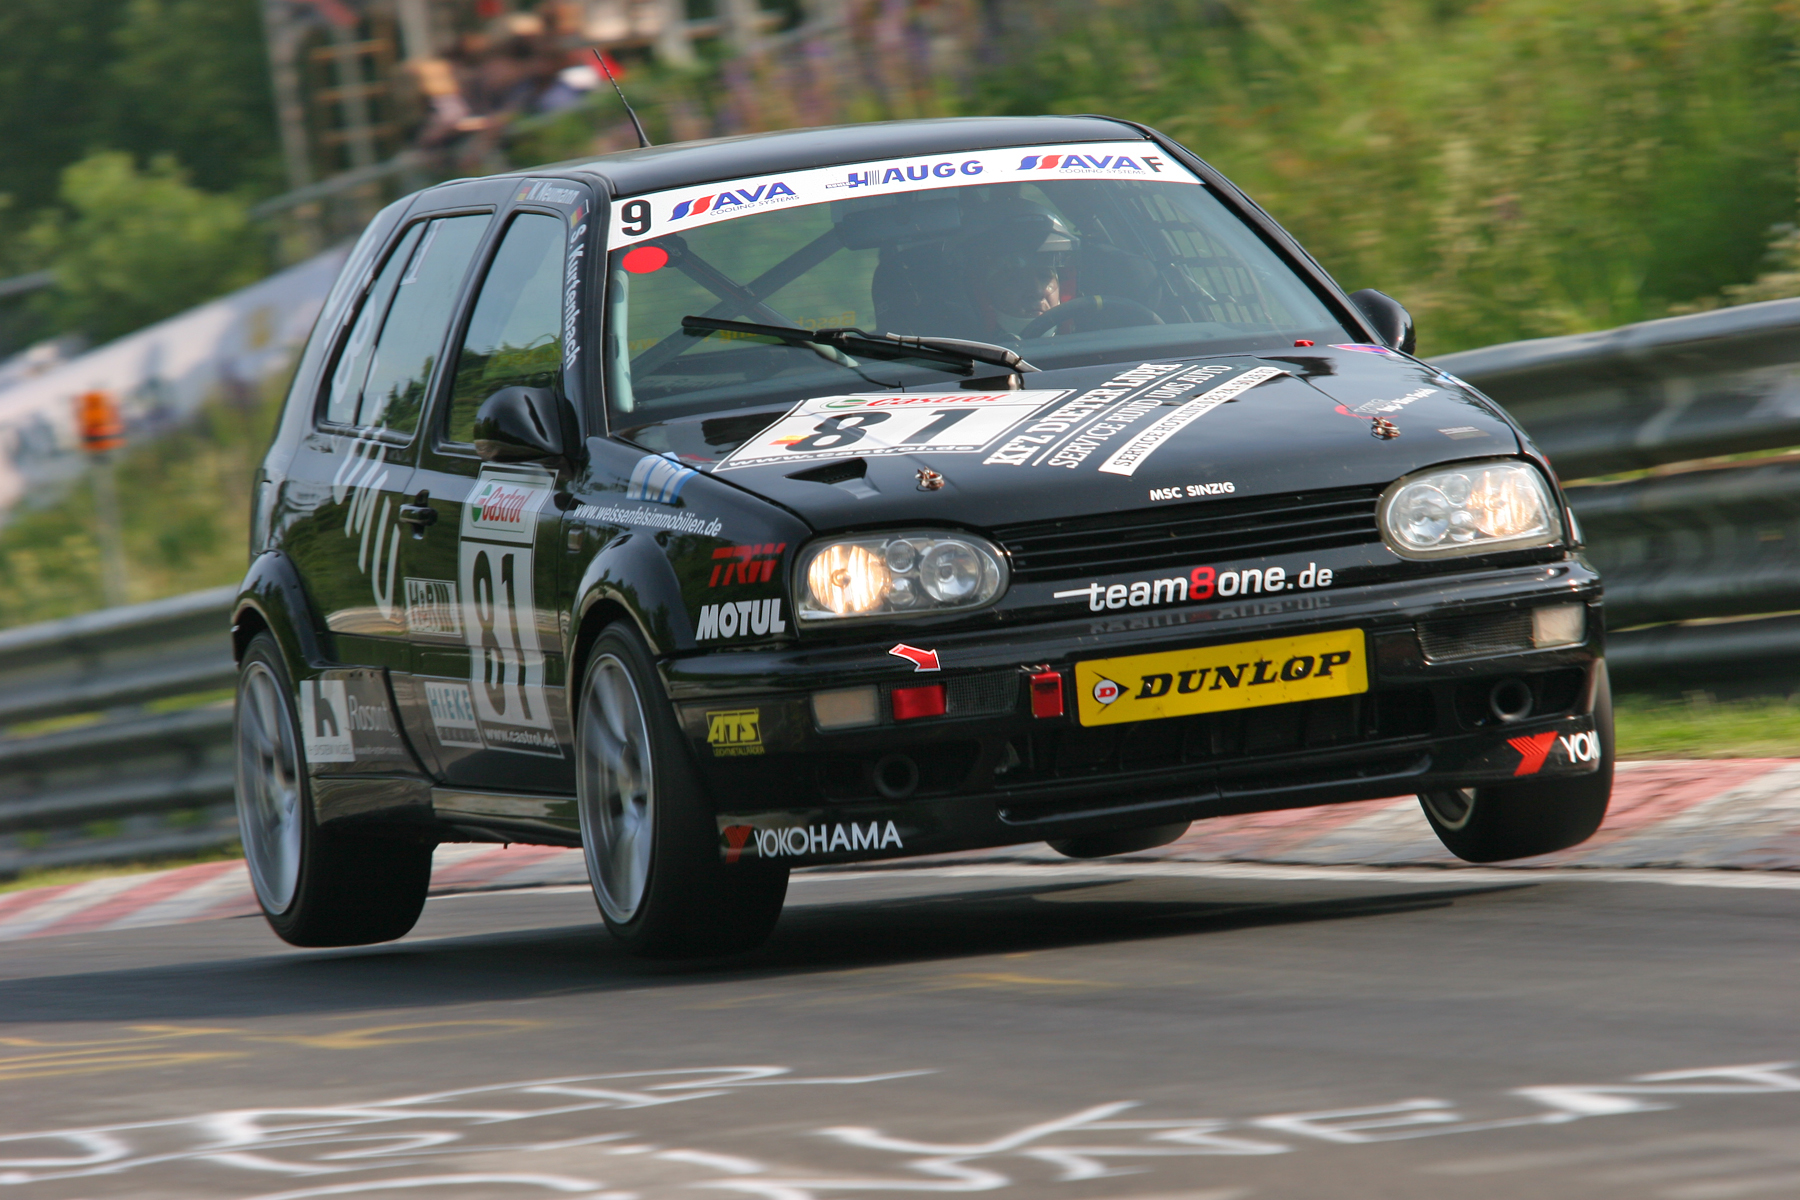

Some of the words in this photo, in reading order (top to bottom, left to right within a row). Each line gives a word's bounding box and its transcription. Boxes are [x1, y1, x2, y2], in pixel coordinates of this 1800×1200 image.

[1141, 156, 1164, 172] F
[621, 199, 652, 236] 9
[710, 202, 756, 216] COOLING
[758, 195, 800, 207] SYSTEMS
[564, 243, 585, 371] Kurtenbach
[866, 393, 1011, 407] Castrol
[1047, 422, 1127, 469] SERVICE
[1105, 399, 1164, 423] RUND
[1144, 382, 1196, 399] UMS
[1177, 365, 1233, 384] AUTO
[785, 408, 982, 451] 81
[983, 434, 1056, 467] KFZ
[1025, 387, 1132, 433] DIETER
[729, 445, 975, 468] www.castrol.de
[1113, 430, 1167, 467] SERVICE
[482, 486, 536, 523] Castrol
[1150, 486, 1183, 501] MSC
[1186, 481, 1236, 498] SINZIG
[573, 503, 723, 537] www.weissenfelsimmobilien.de
[708, 542, 787, 588] TRW
[1087, 562, 1334, 612] team8one.de
[472, 550, 533, 721] 81
[695, 598, 787, 641] MOTUL
[1134, 650, 1352, 700] DUNLOP
[427, 687, 475, 721] HIEKE
[707, 713, 760, 743] ATS
[754, 820, 903, 858] YOKOHAMA
